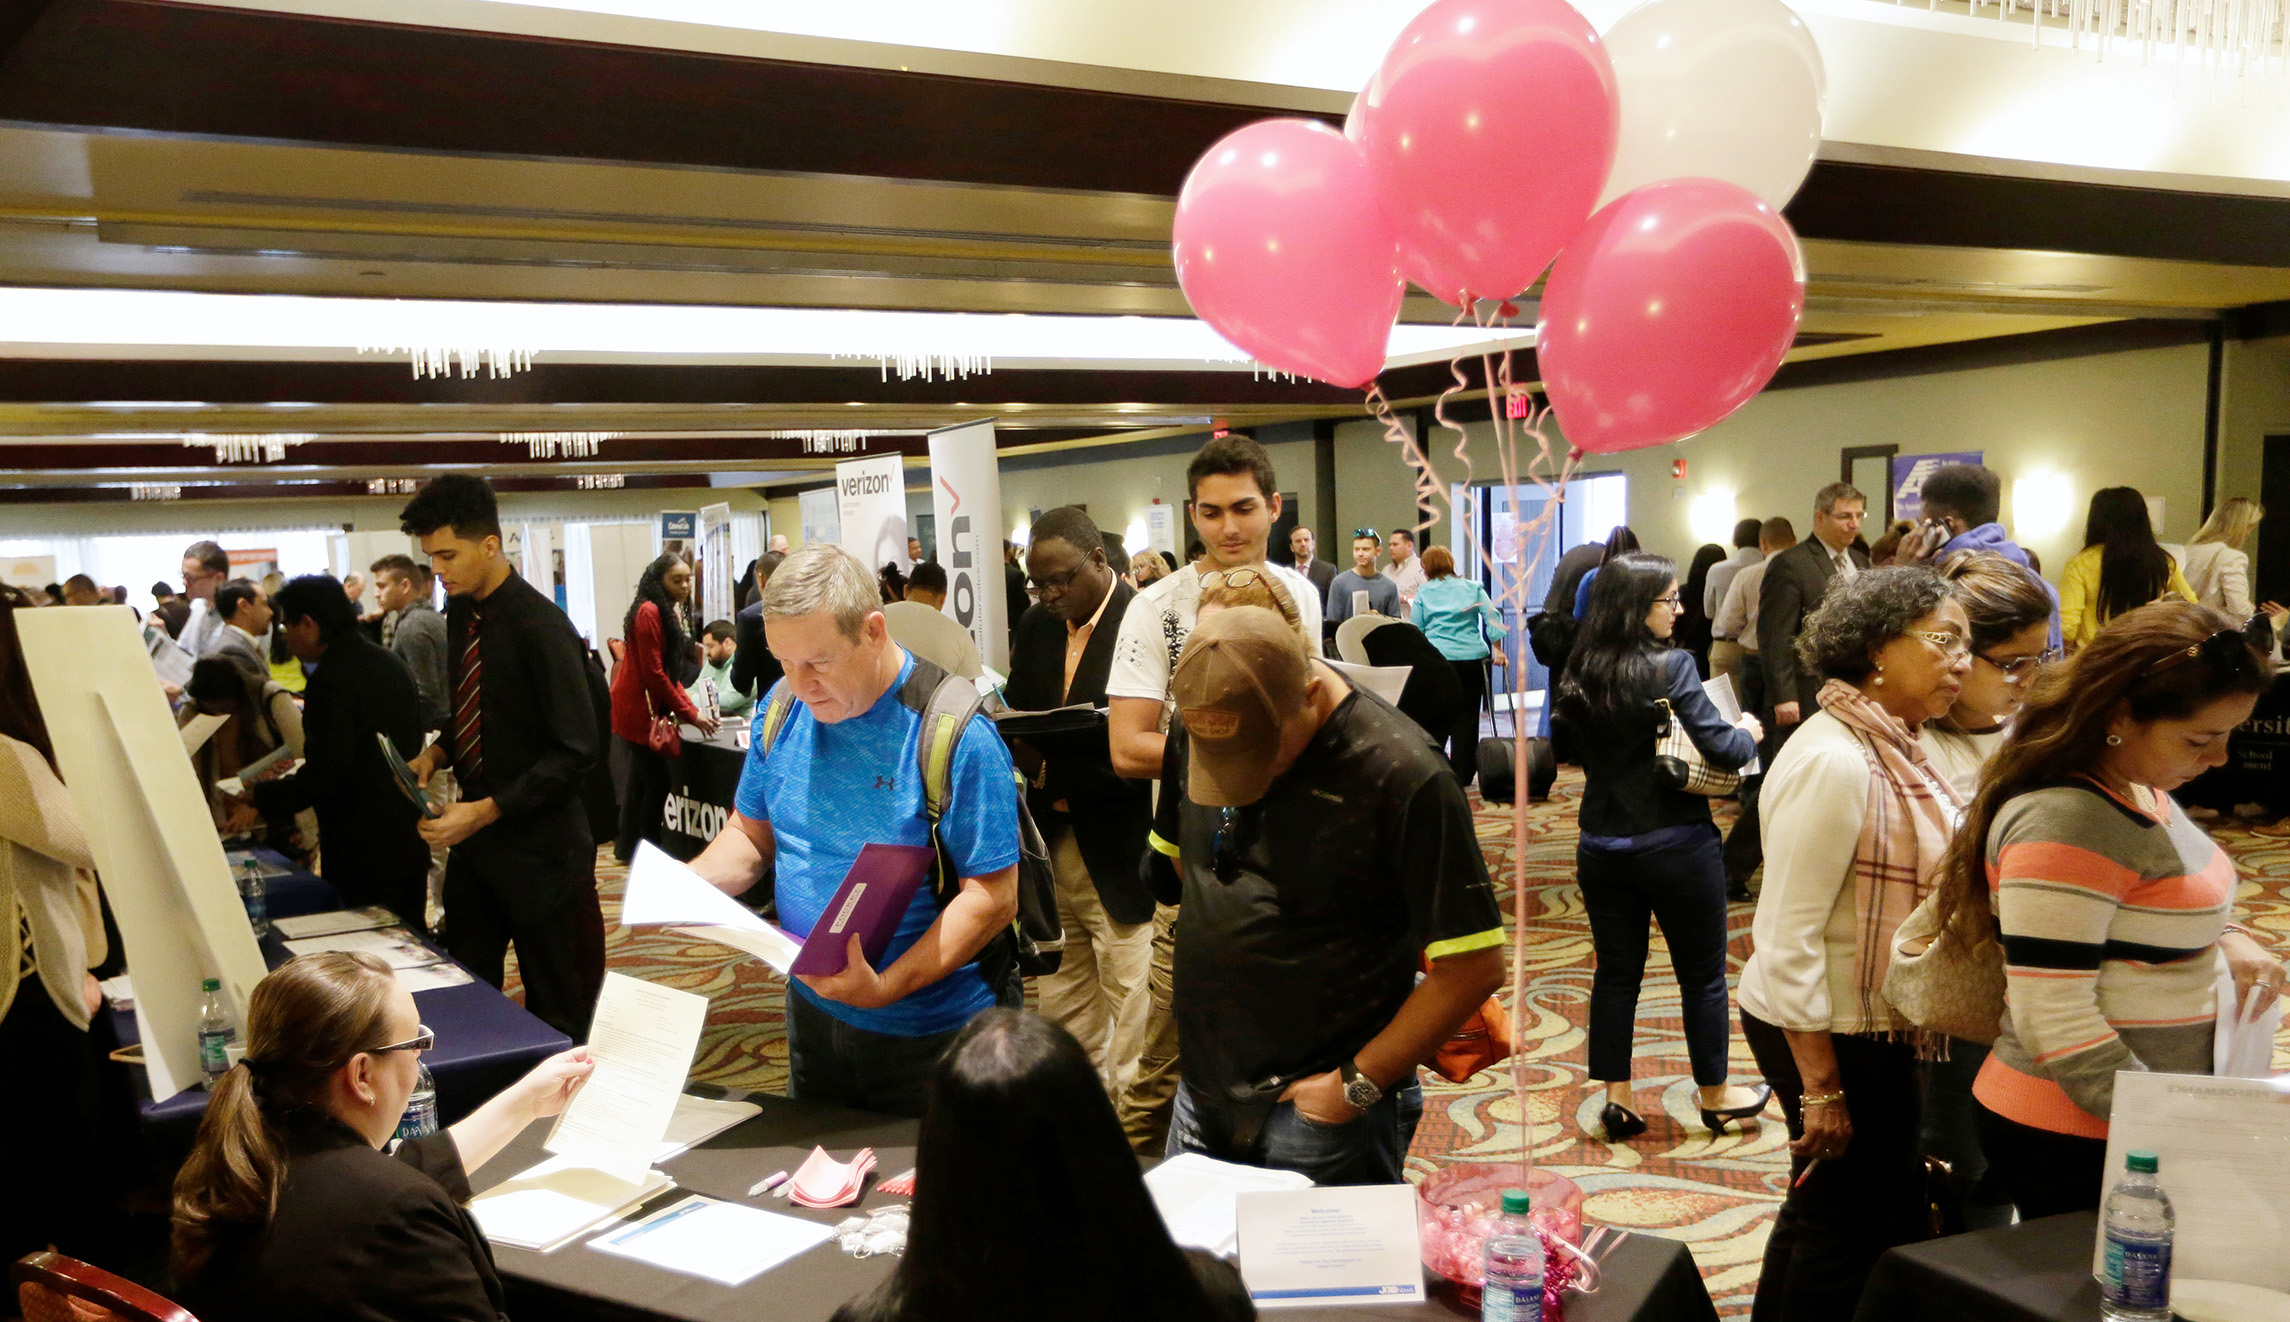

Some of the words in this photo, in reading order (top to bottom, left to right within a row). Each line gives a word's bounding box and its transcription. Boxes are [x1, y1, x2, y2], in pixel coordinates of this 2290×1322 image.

[1506, 394, 1528, 418] EXIT
[841, 470, 889, 496] verizon
[661, 785, 728, 842] erizon
